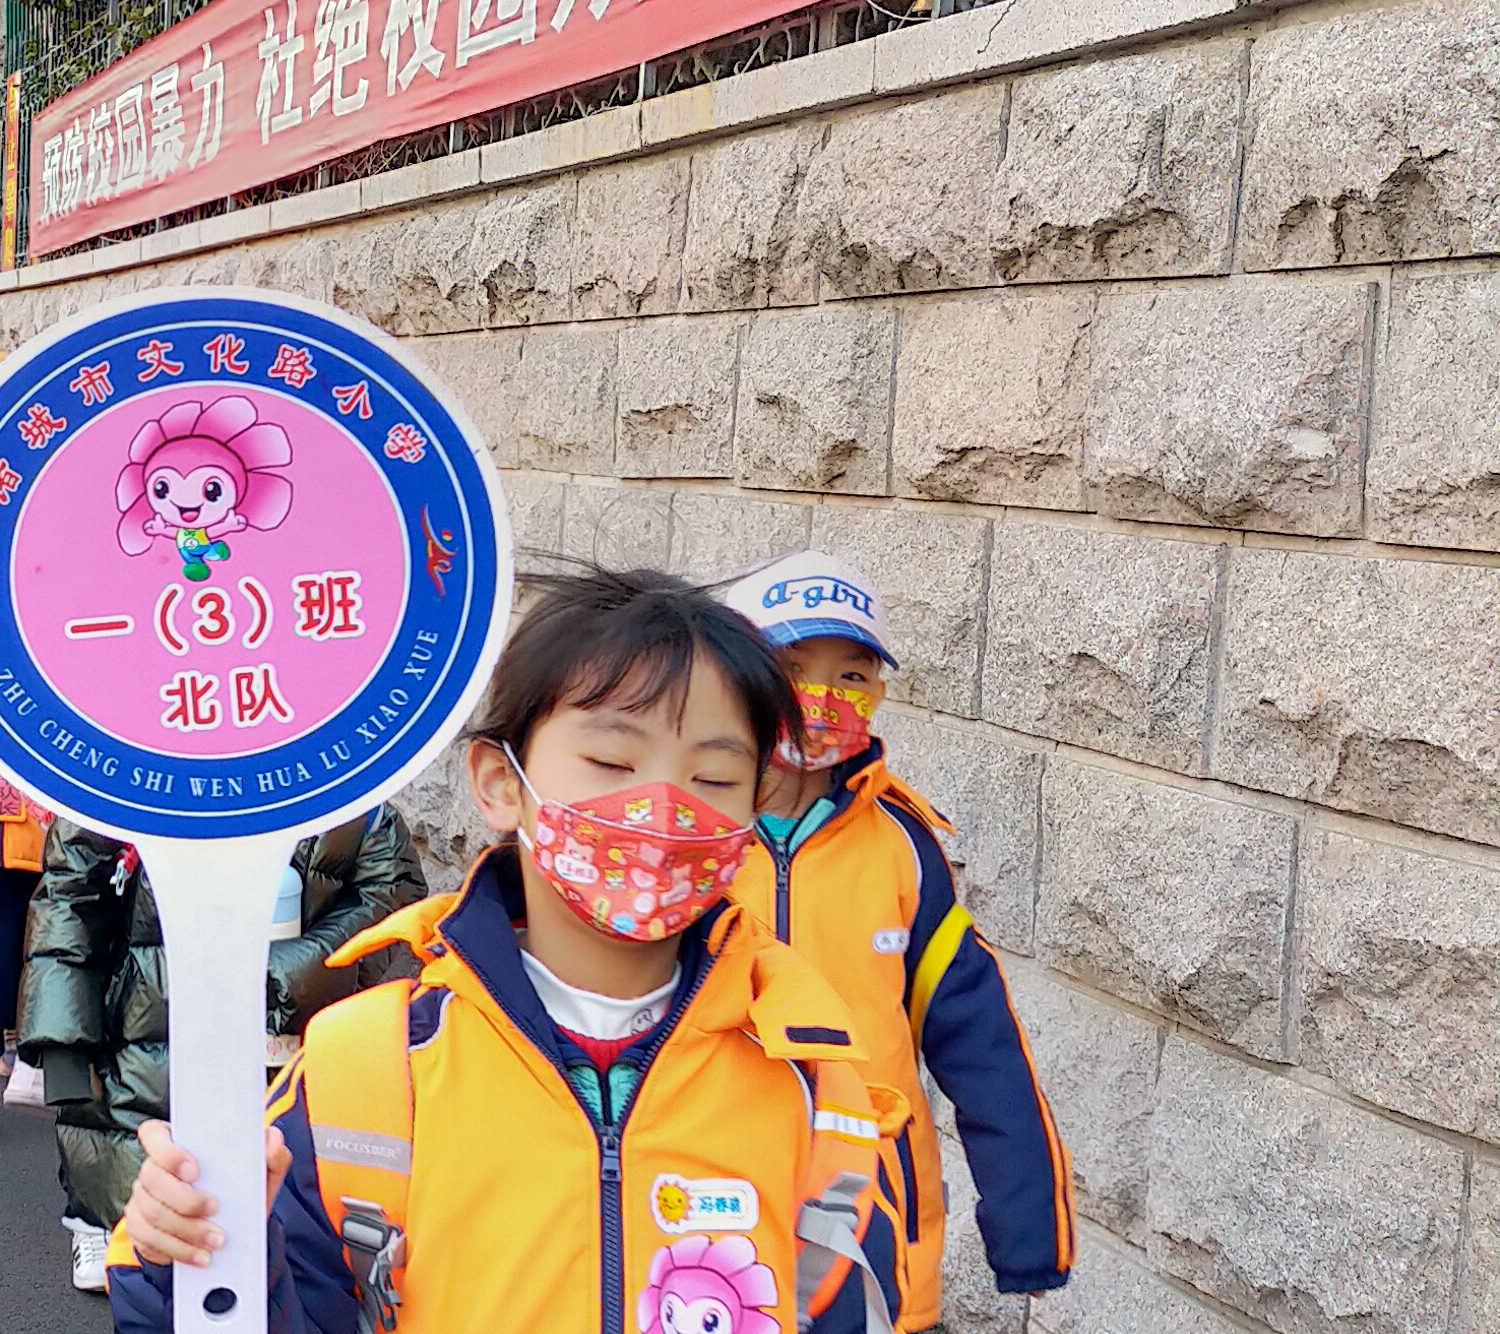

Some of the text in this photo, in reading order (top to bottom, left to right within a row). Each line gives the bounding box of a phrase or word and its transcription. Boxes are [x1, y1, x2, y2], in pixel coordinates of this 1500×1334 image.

[40, 43, 226, 226] 预防校园暴力
[38, 719, 119, 778] CHENG
[130, 766, 175, 795] SHI
[189, 775, 244, 798] WEN
[257, 761, 313, 795] HUA
[323, 741, 353, 772] LU
[357, 686, 411, 746] XIAO
[403, 628, 440, 682] XUE
[161, 664, 294, 731] 北队
